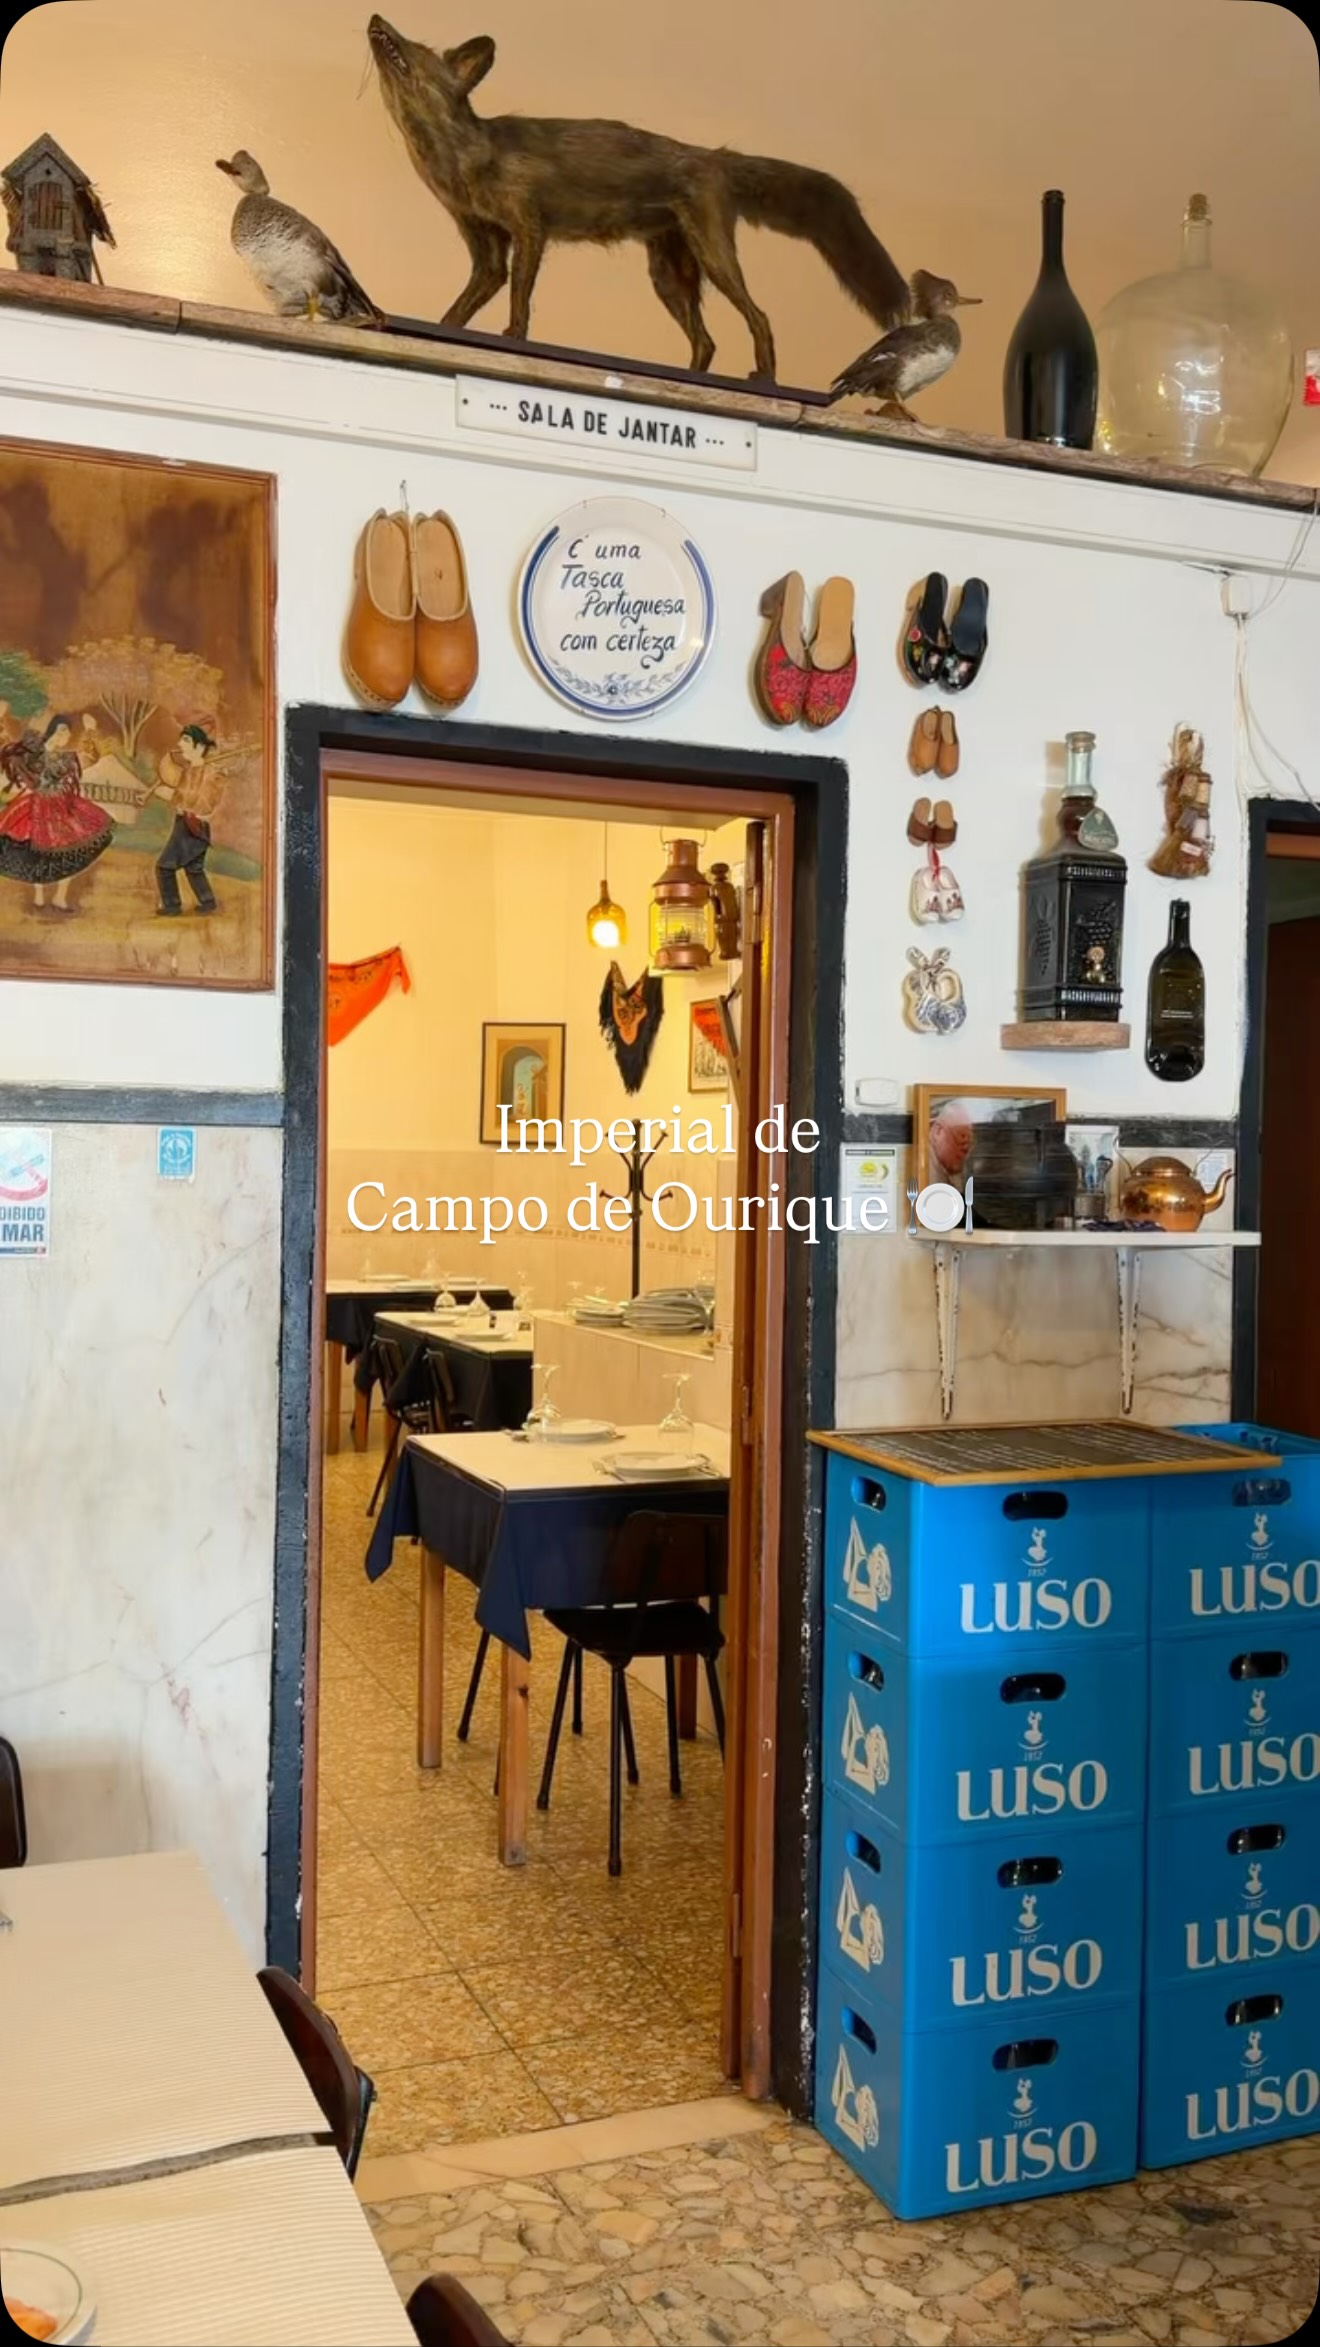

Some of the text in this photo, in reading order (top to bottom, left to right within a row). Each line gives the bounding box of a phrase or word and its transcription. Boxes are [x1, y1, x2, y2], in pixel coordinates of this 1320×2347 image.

[517, 401, 697, 449] SALA DE JANTAR
[560, 564, 624, 589] Tasca
[595, 546, 642, 559] uma
[575, 589, 687, 629] Portuguesa
[560, 626, 677, 670] com certeza
[959, 1578, 1112, 1634] LUSO
[1189, 1559, 1320, 1616] LUSO
[956, 1760, 1108, 1822] LUSO
[1188, 1732, 1320, 1796] LUSO
[1185, 1903, 1320, 1970] LUSO
[949, 1939, 1103, 2007] LUSO
[1185, 2068, 1320, 2141] LUSO
[944, 2121, 1097, 2194] LUSO
